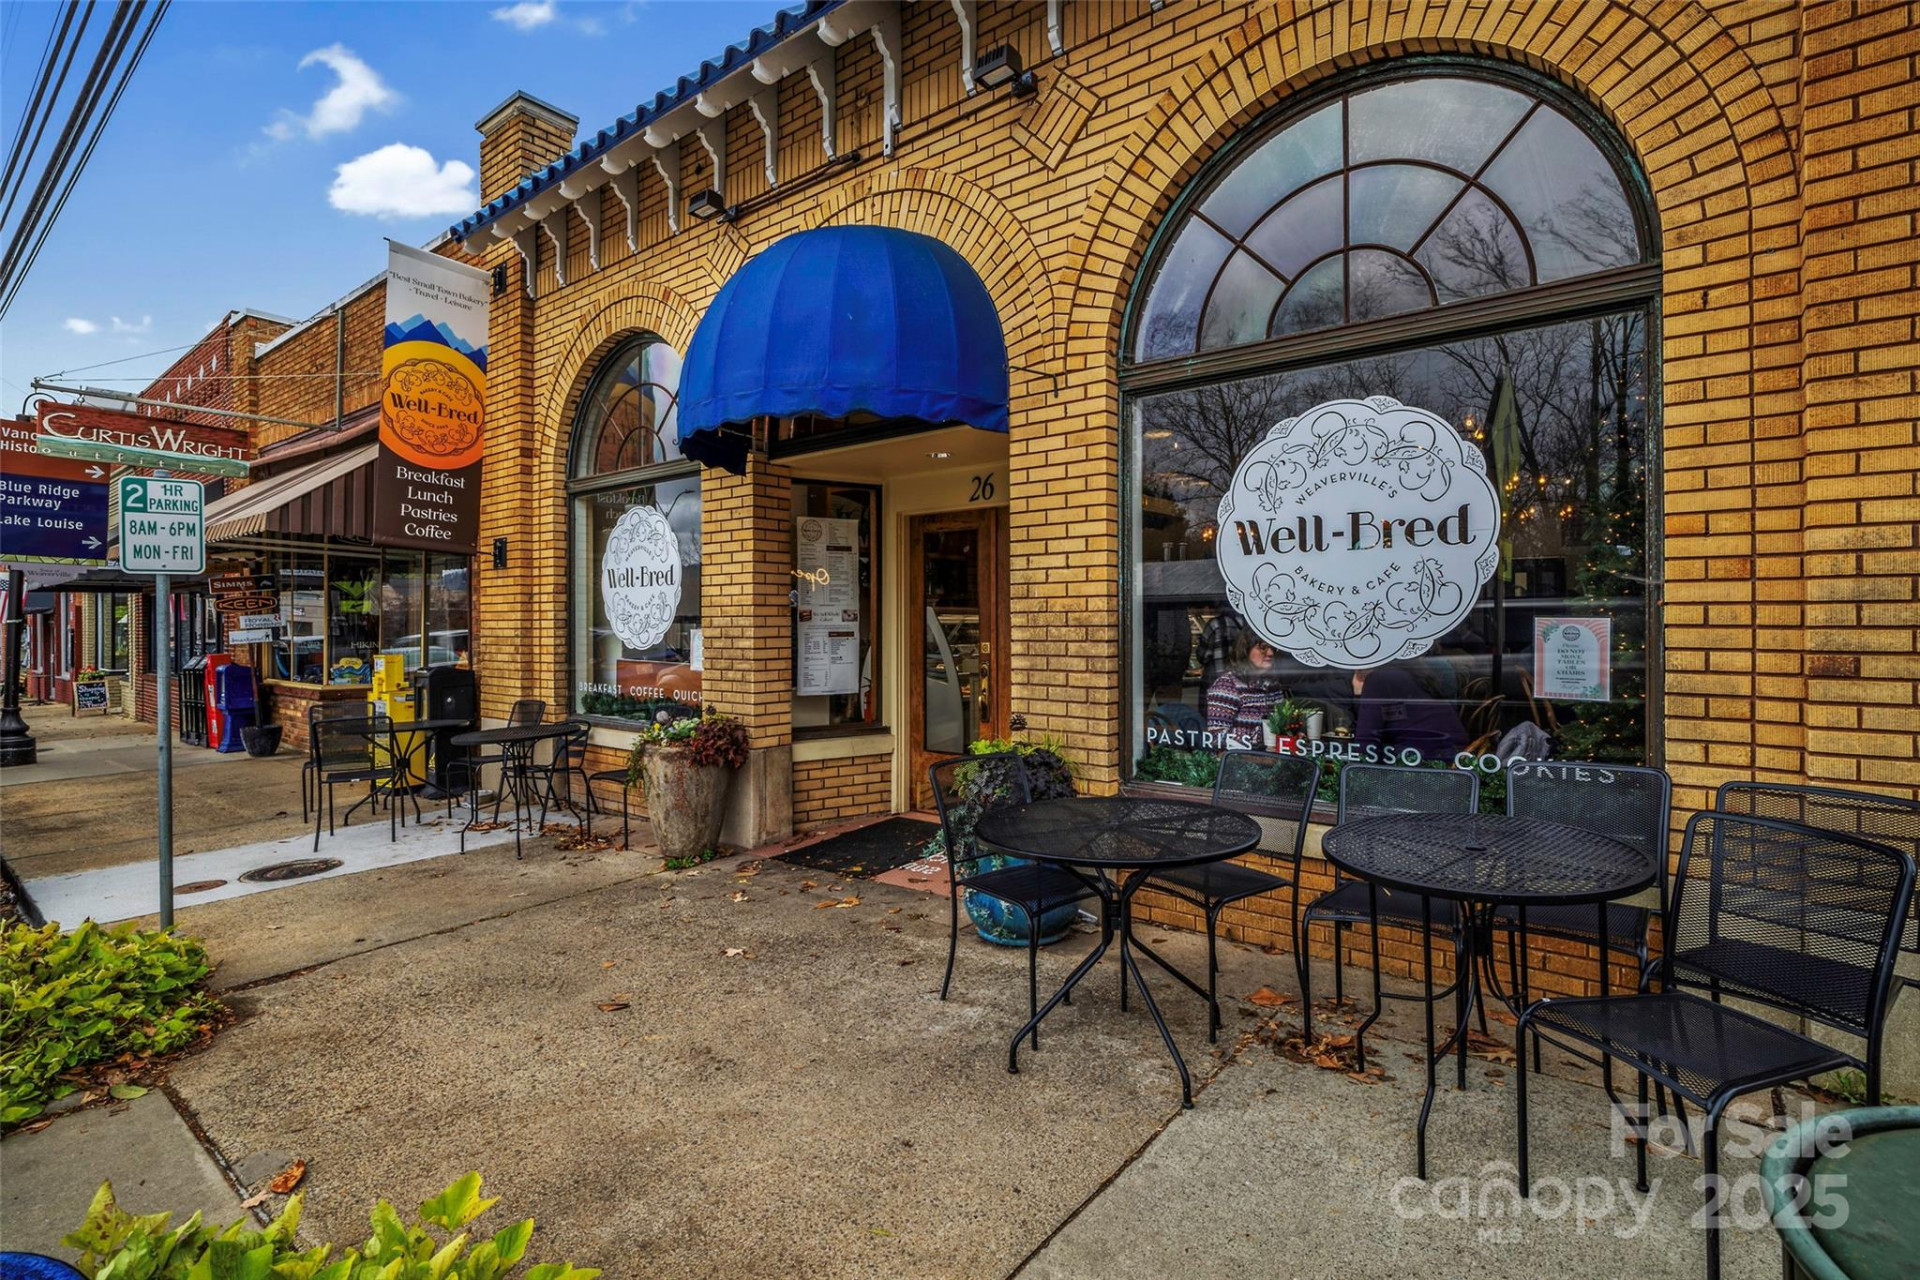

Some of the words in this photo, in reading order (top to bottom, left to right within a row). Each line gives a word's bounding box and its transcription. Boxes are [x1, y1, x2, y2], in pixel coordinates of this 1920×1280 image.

[412, 277, 435, 291] Small
[436, 286, 458, 298] Town
[413, 287, 439, 301] Travel
[444, 298, 473, 311] Leisure
[390, 392, 479, 425] Well-Bred
[396, 466, 466, 489] Breakfast
[969, 473, 995, 502] 26
[0, 480, 32, 493] Blue
[39, 484, 80, 499] Ridge
[125, 484, 144, 507] 2
[163, 484, 183, 497] HR
[407, 486, 453, 505] Lunch
[1295, 471, 1398, 506] WEAVERVILLE'S
[0, 493, 61, 511] Parkway
[149, 498, 199, 512] PARKING
[37, 517, 84, 530] Louise
[400, 503, 458, 523] Pastries
[404, 522, 452, 540] Coffee
[1233, 503, 1477, 556] Well-Bred
[213, 580, 253, 589] SIMMS
[607, 564, 675, 589] Well-Bred
[1294, 565, 1346, 596] BAKERY
[1351, 585, 1361, 595] &
[1366, 562, 1402, 590] CAFE
[219, 599, 273, 609] KEEN
[579, 682, 622, 695] BREAKFAST
[630, 686, 664, 699] COFFEE
[1147, 727, 1252, 750] PASTRIES
[1278, 737, 1422, 767] ESPRESSO
